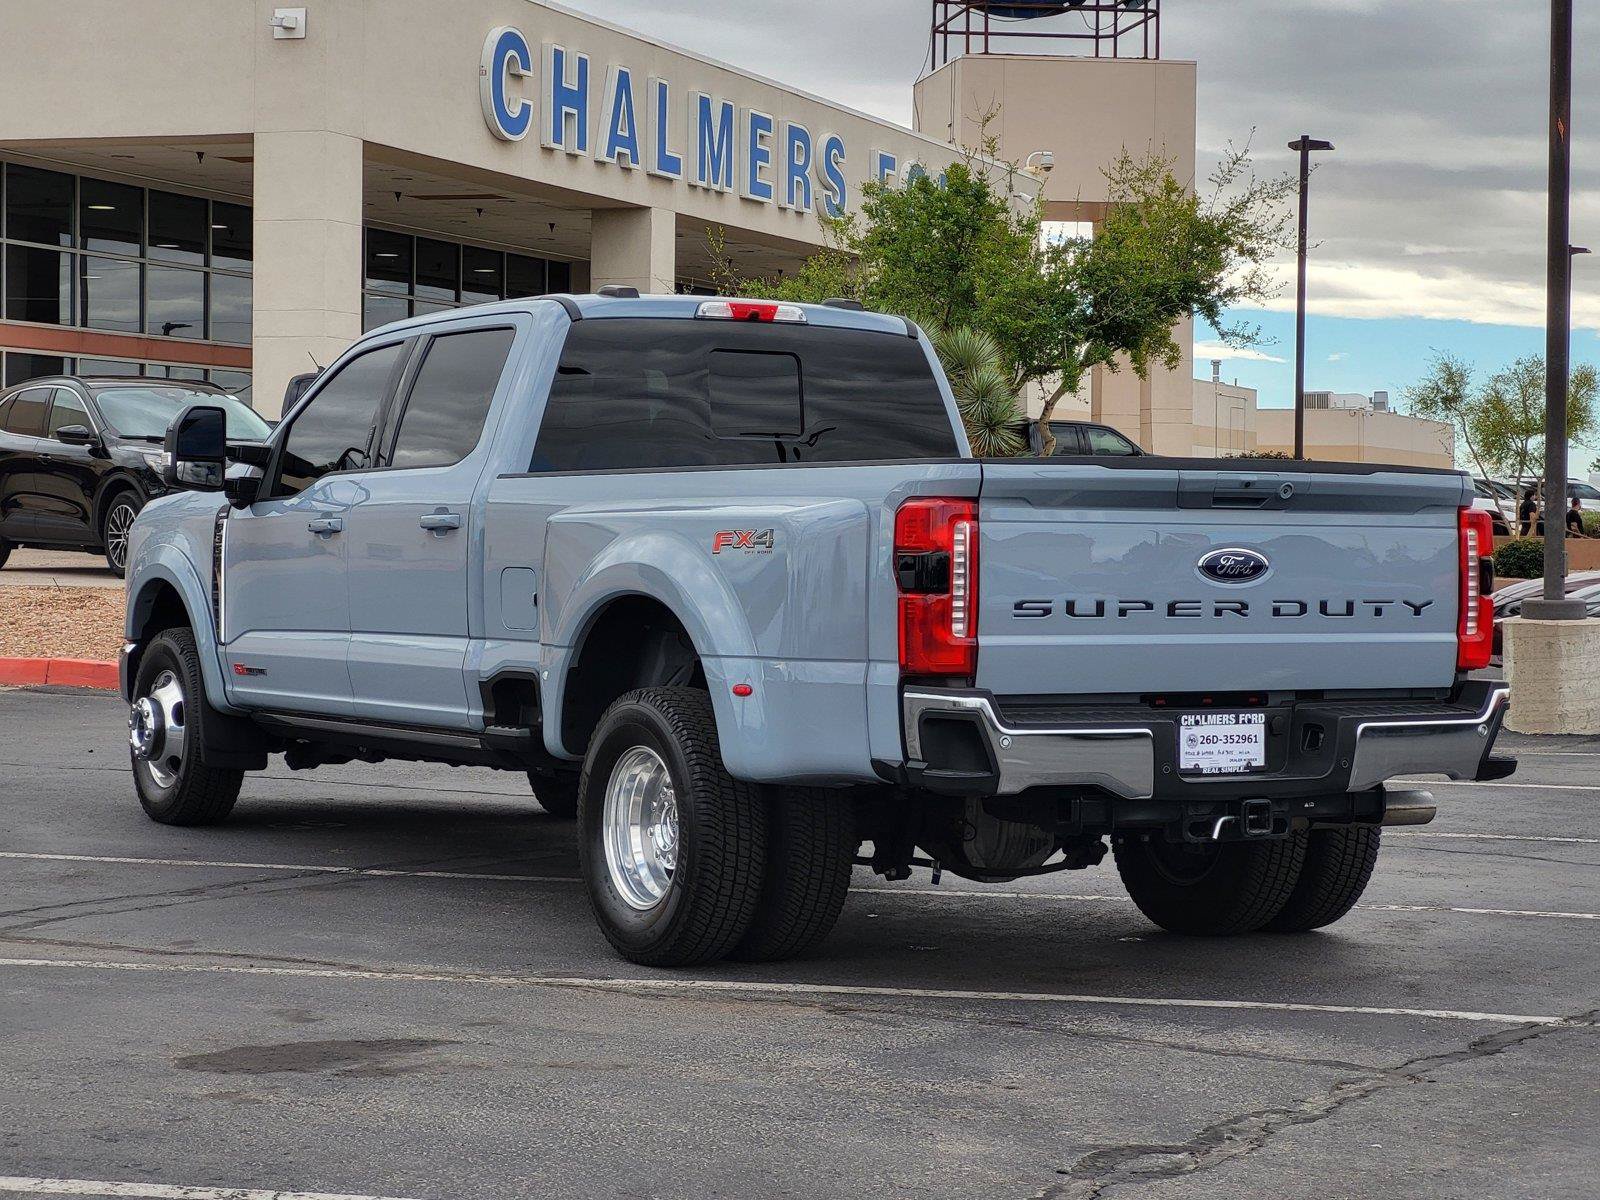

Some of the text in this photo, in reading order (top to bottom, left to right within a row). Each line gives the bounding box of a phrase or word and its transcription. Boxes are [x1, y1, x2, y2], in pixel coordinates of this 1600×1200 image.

[480, 26, 848, 220] CHALMERS
[712, 529, 774, 555] FX4
[1216, 555, 1255, 575] Ford
[1012, 599, 1435, 619] SUPER DUTY
[1181, 714, 1236, 726] CHALMERS
[1199, 734, 1259, 745] 26D-352961
